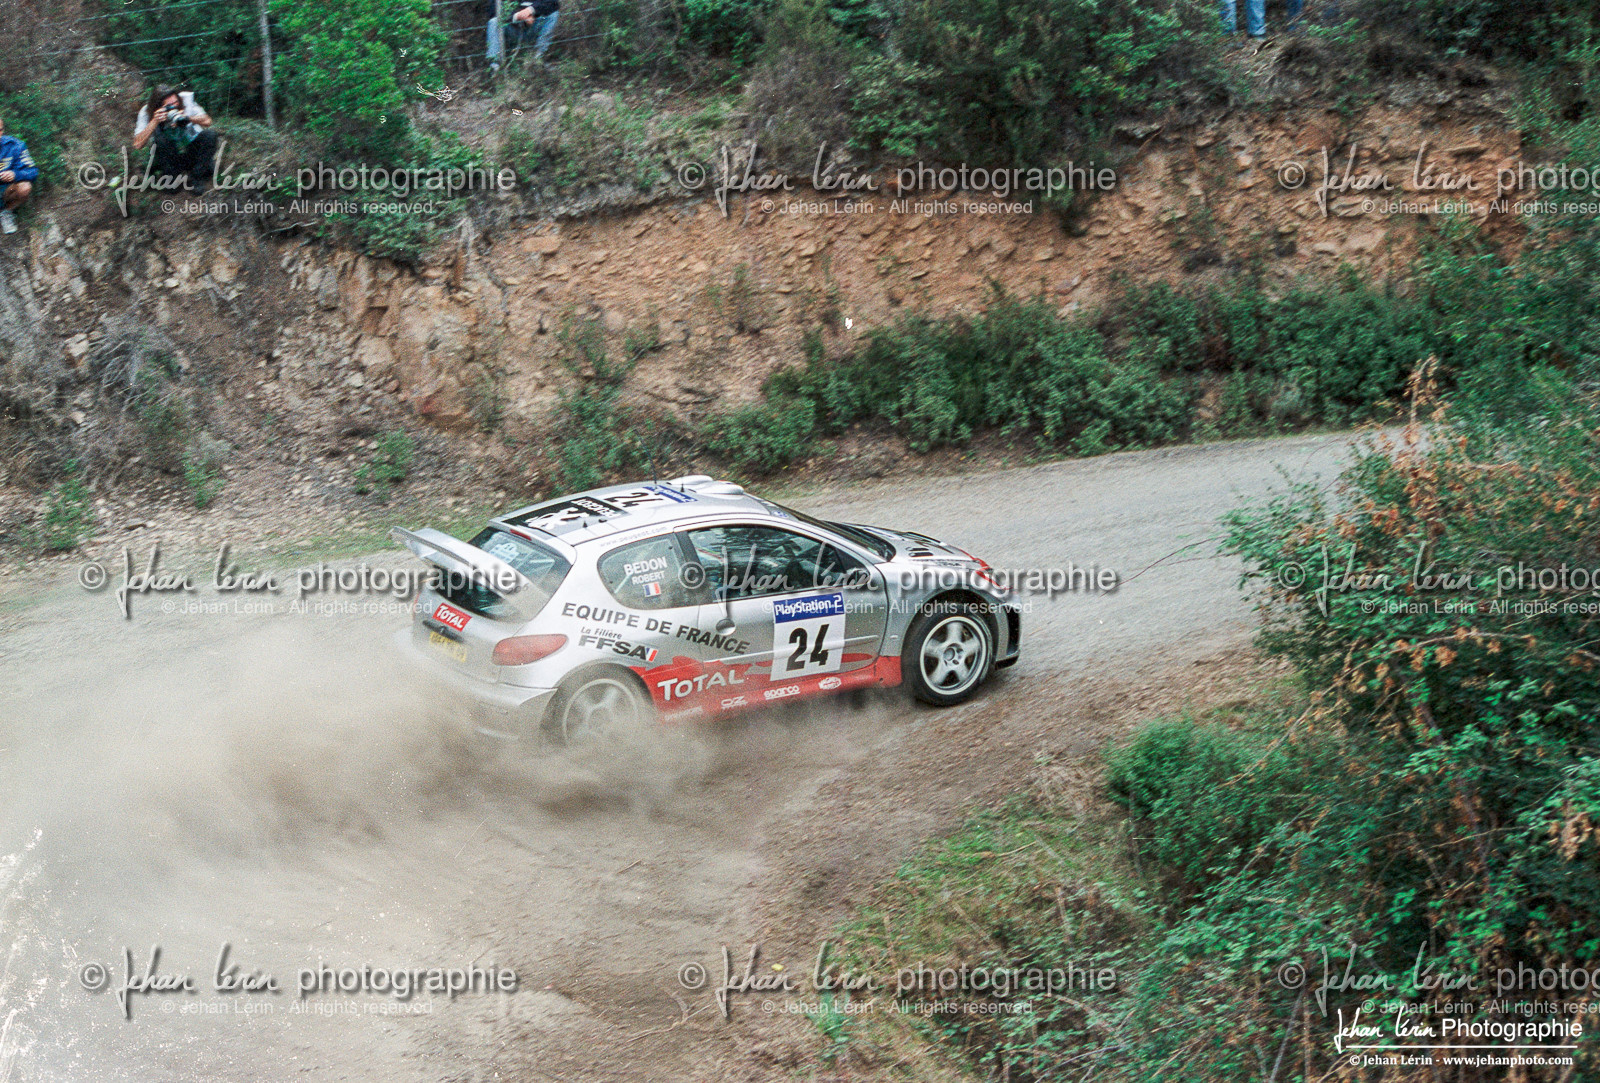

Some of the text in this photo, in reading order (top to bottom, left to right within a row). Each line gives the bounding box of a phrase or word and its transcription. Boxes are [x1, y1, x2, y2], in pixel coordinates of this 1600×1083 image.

[623, 556, 668, 576] BEDON
[631, 570, 665, 585] ROBERT
[436, 605, 465, 629] TOTAL
[561, 602, 751, 655] EQUIPE DE FRANCE
[581, 626, 592, 635] La
[578, 634, 647, 660] FFSA
[786, 623, 830, 671] 24
[657, 669, 745, 701] TOTAL
[763, 685, 800, 699] sparco
